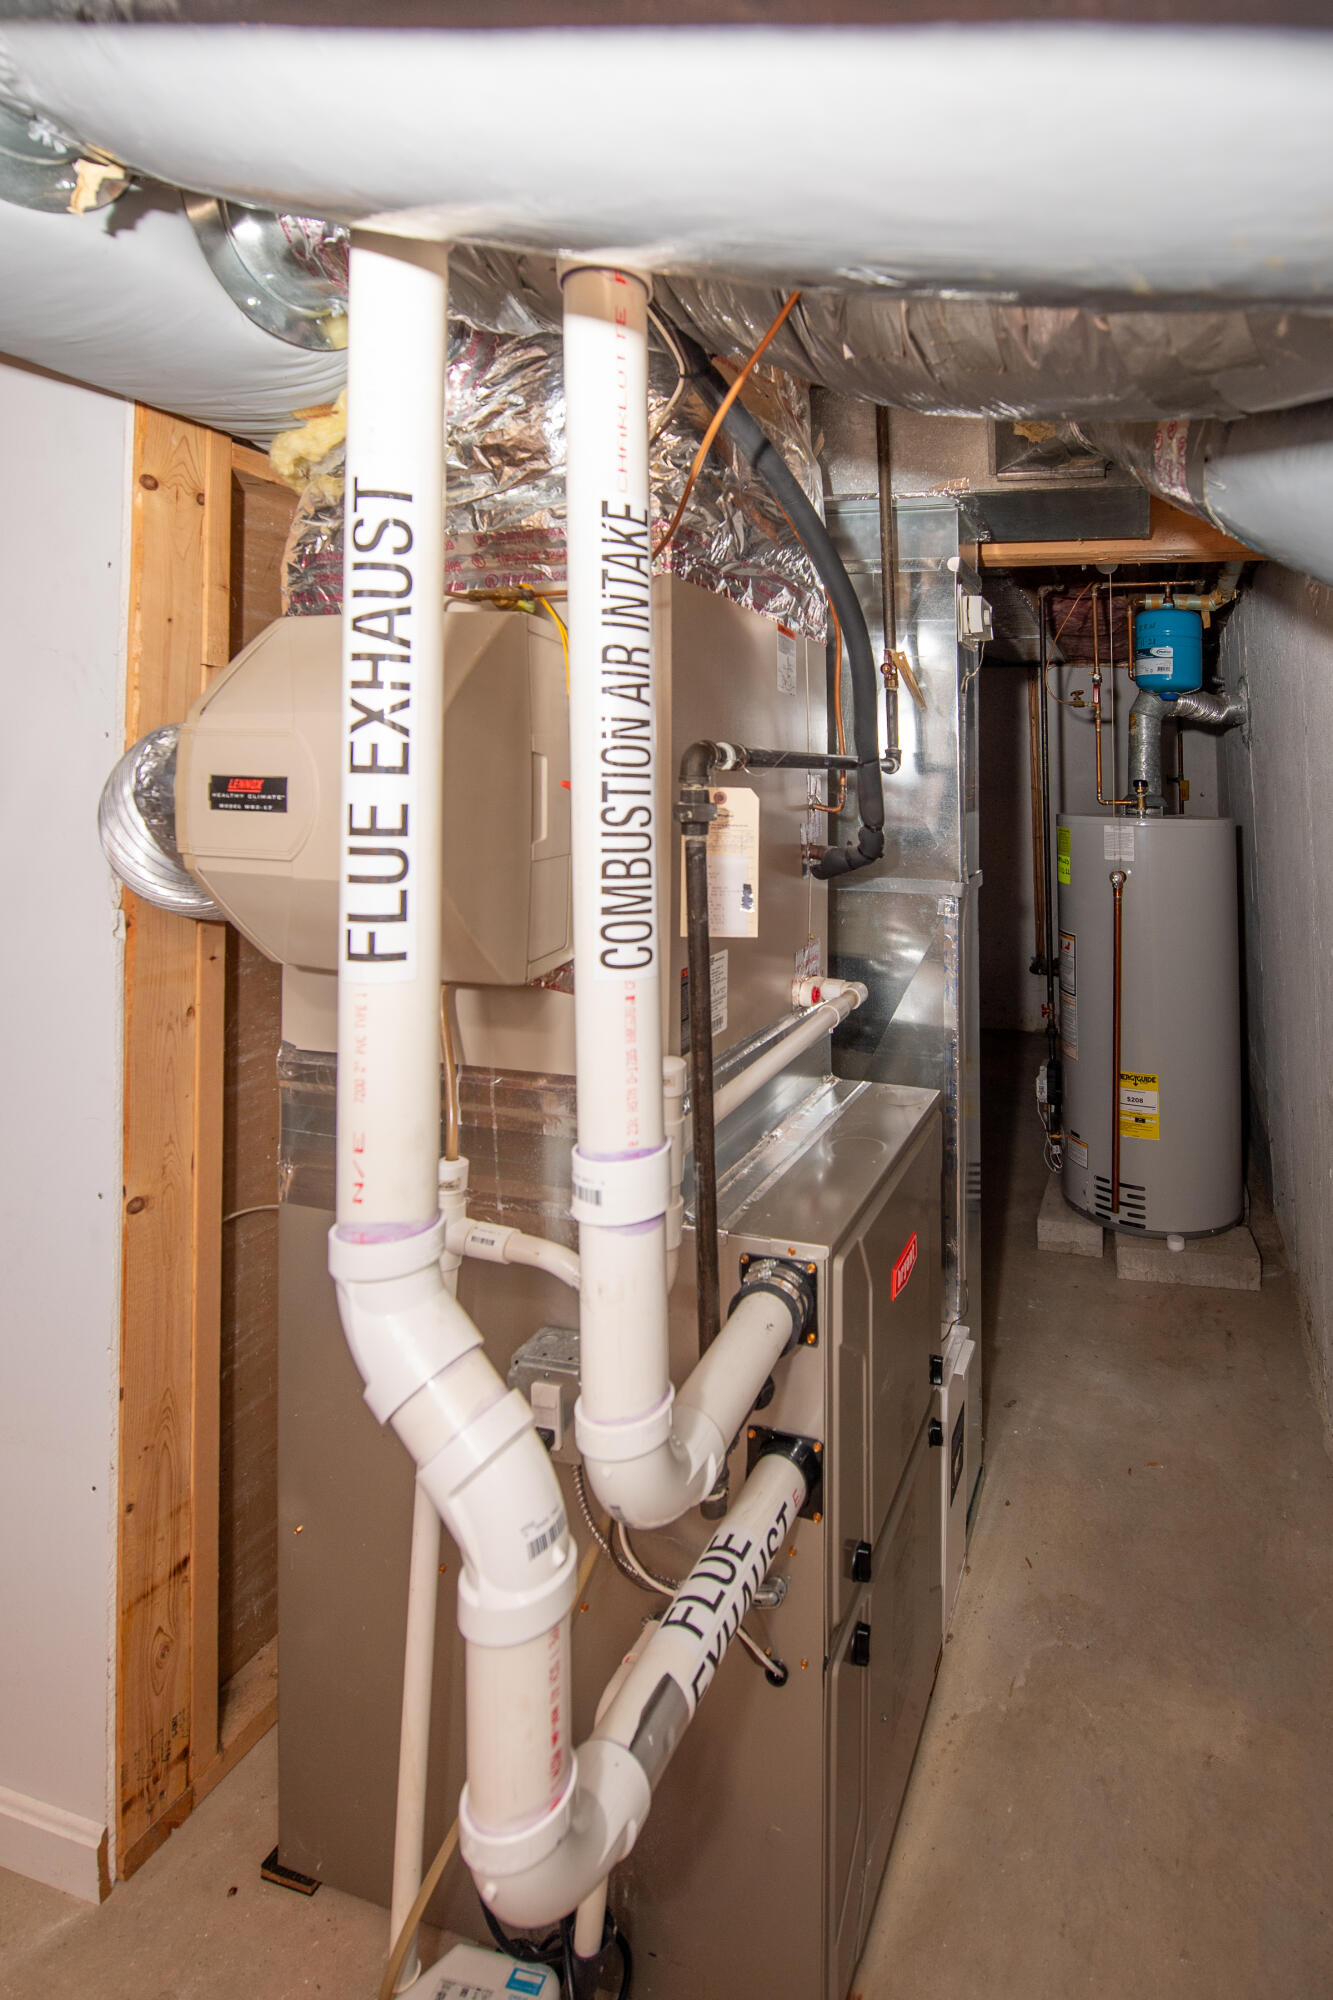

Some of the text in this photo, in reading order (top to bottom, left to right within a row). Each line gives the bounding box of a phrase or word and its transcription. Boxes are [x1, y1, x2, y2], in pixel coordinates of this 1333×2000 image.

[346, 476, 414, 963] FLUE EXHAUST
[600, 501, 653, 970] COMBUSTION AIR INTAKE
[661, 1533, 752, 1641] FLUE
